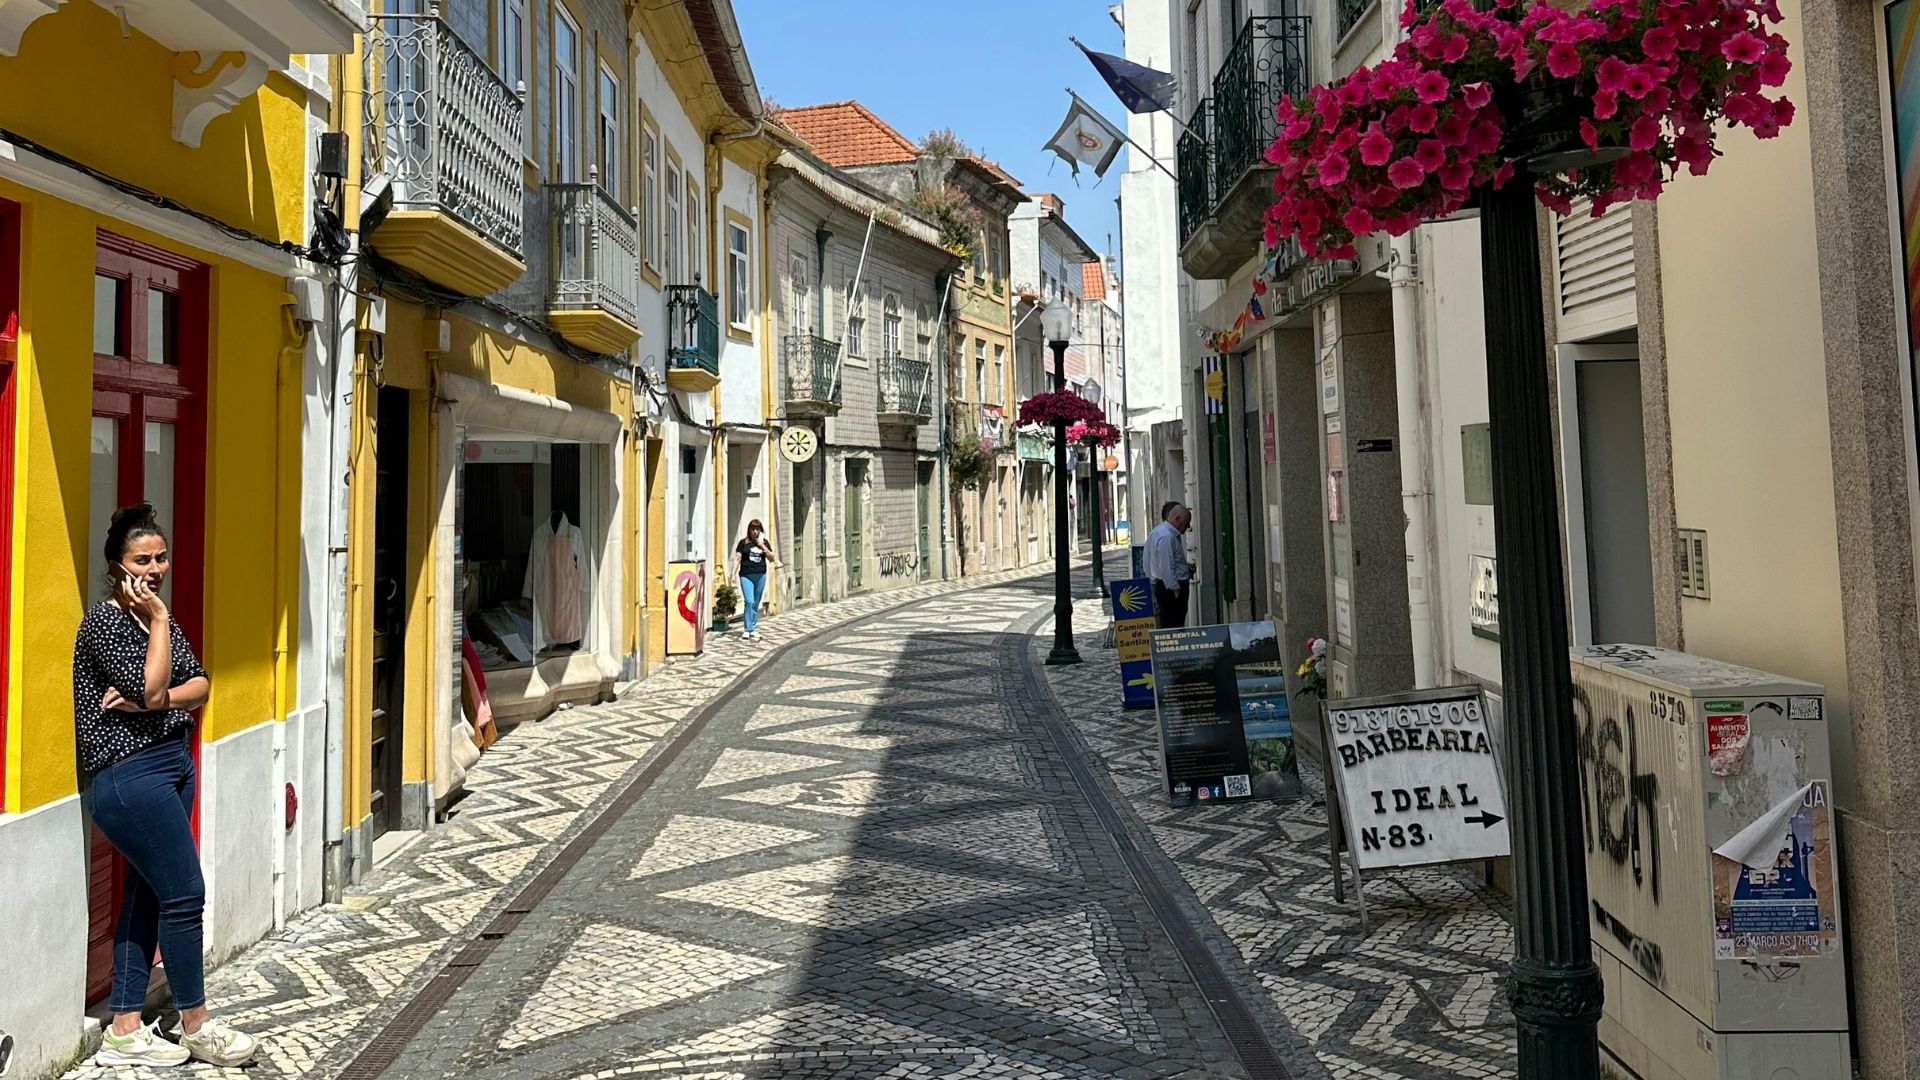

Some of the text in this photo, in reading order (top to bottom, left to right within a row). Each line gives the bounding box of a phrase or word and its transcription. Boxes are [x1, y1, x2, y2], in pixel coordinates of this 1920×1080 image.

[1117, 622, 1155, 633] Caminho
[1154, 633, 1172, 641] BIKE
[1172, 631, 1200, 639] RENTAL
[1155, 641, 1224, 653] LUGGAGE STORAGE
[1649, 690, 1686, 726] 8579
[1337, 728, 1491, 768] BARBEARIA
[1371, 783, 1479, 814] IDEAL
[1736, 936, 1747, 947] 23
